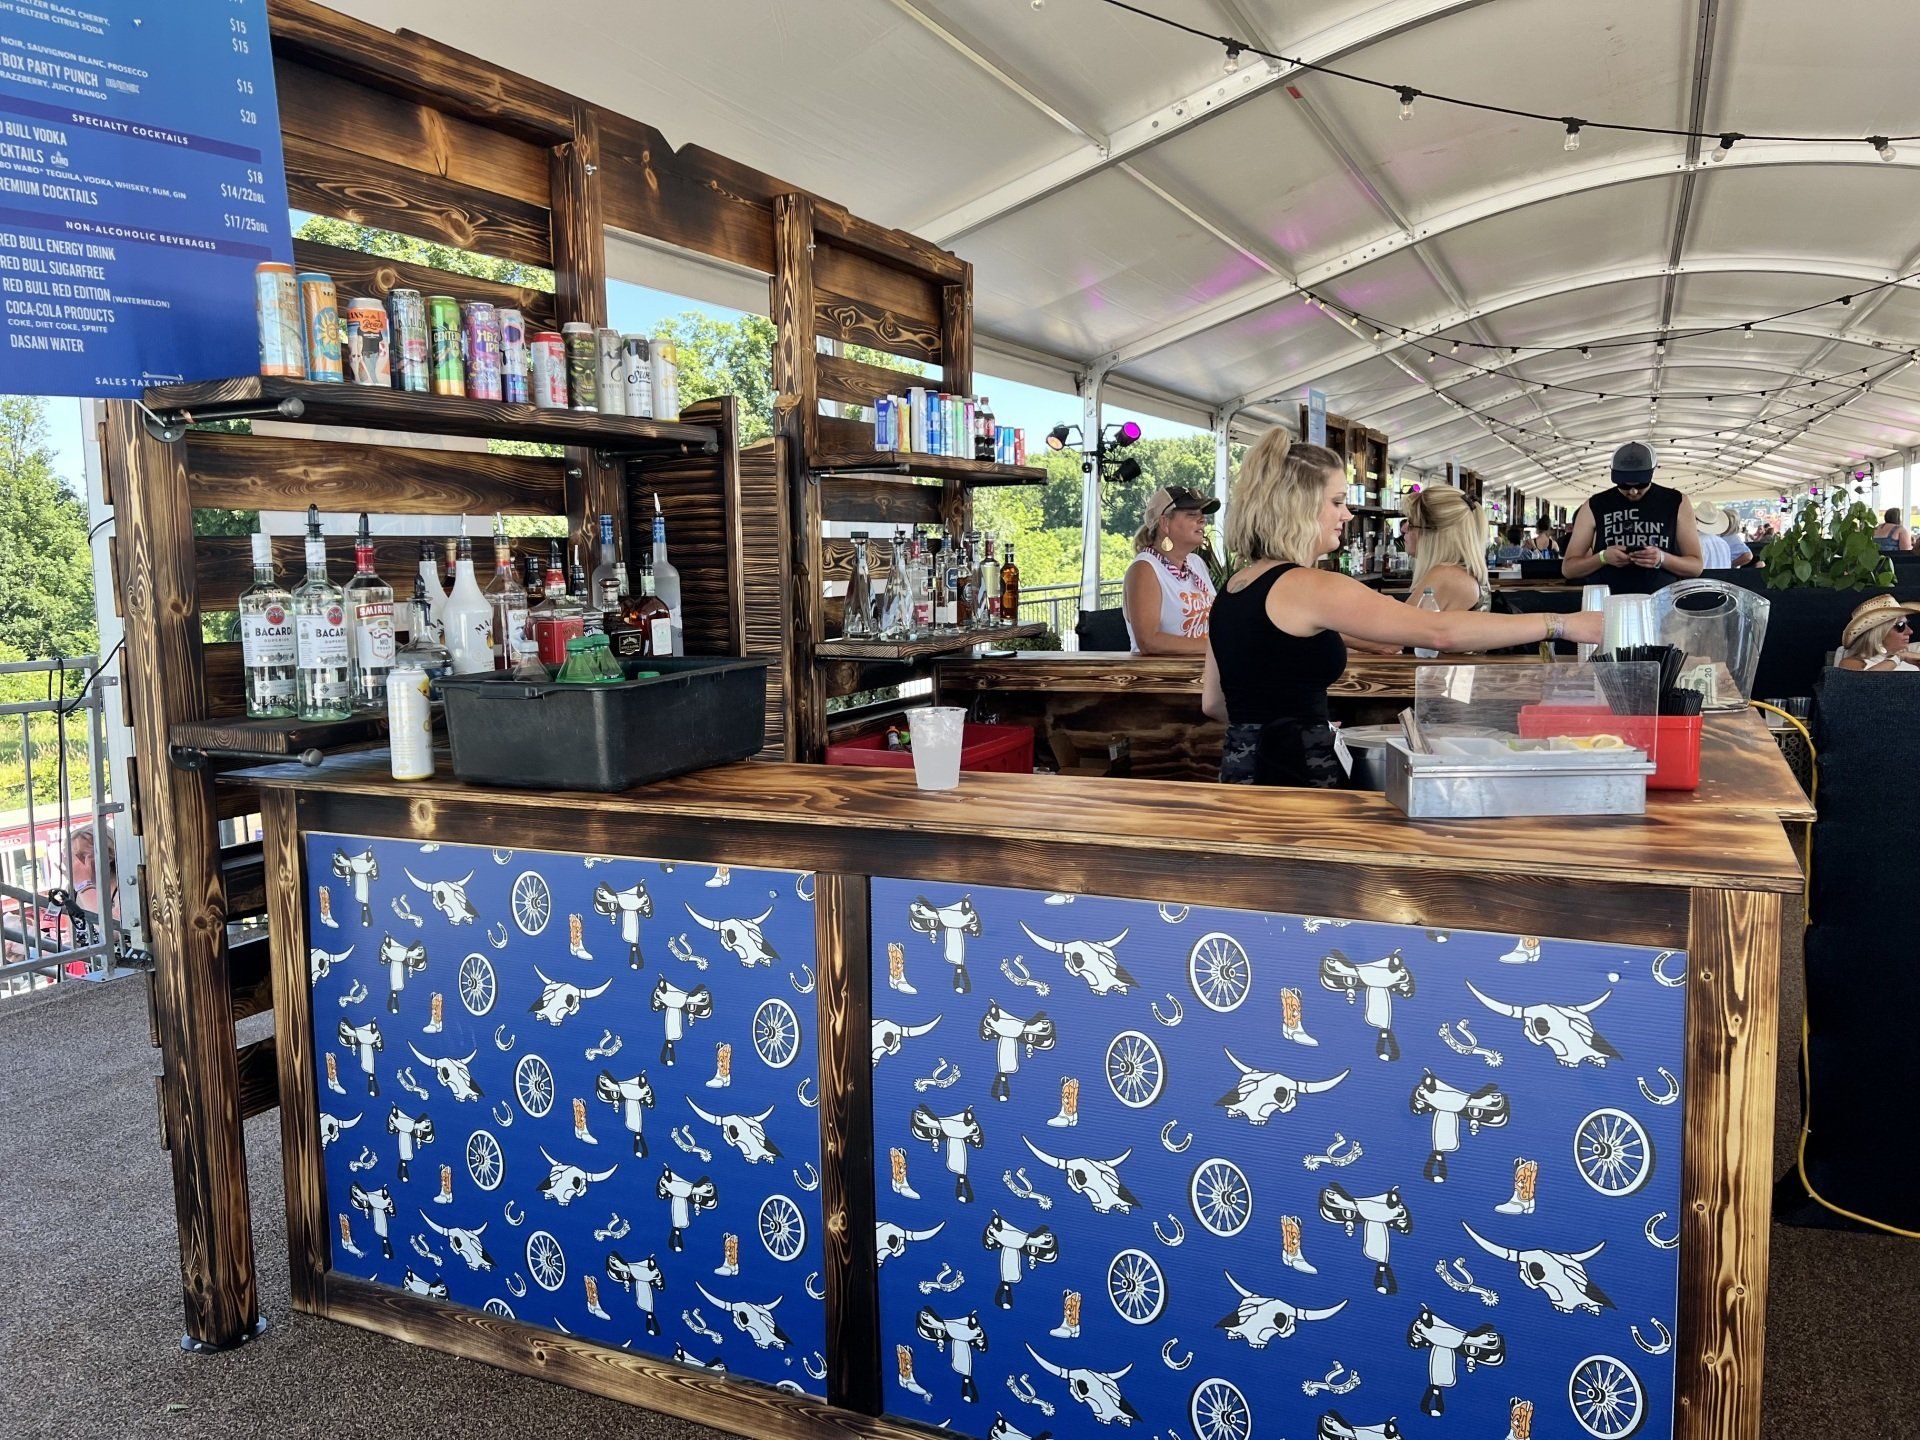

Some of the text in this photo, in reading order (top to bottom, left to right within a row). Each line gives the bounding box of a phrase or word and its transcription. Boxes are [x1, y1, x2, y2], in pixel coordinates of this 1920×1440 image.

[16, 6, 50, 21] SELTZER
[51, 15, 80, 29] CITRUS
[81, 23, 104, 35] SODA
[50, 3, 76, 17] BLACK
[77, 11, 110, 26] CHERRY,
[230, 18, 246, 34] $15
[232, 38, 248, 54] $15
[27, 43, 77, 61] SAUVIGNON
[78, 55, 106, 69] BLANC,
[107, 62, 149, 78] PROSECCO
[27, 58, 61, 79] PARTY
[63, 66, 98, 87] PUNCH
[51, 83, 75, 95] JUICY
[76, 87, 107, 100] MANGO
[237, 78, 253, 94] $15
[240, 109, 257, 124] $20
[5, 121, 32, 140] BULL
[32, 126, 67, 146] VODKA
[72, 113, 188, 145] SPECIALTY COCKTAILS
[45, 169, 82, 182] TEQUILA,
[83, 175, 114, 188] VODKA,
[114, 180, 151, 194] WHISKEY,
[152, 187, 172, 198] RUM,
[173, 191, 187, 200] GIN
[247, 169, 263, 184] $18
[42, 183, 98, 206] COCKTAILS
[65, 220, 217, 251] NON-ALCOHOLIC BEVERAGES
[18, 235, 45, 252] BULL
[46, 239, 84, 257] ENERGY
[86, 245, 116, 261] DRINK
[0, 255, 106, 280] RED BULL SUGARFREE
[2, 277, 171, 309] RED BULL RED EDITION (WATERMELON)
[5, 300, 115, 323] COCA-COLA PRODUCTS
[7, 318, 108, 334] COKE, DIET COKE, SPRITE
[10, 334, 84, 353] DASANI WATER
[95, 376, 127, 386] SALES
[130, 378, 151, 387] TAX
[1603, 508, 1639, 525] ERIC
[1605, 534, 1669, 549] CHURCH
